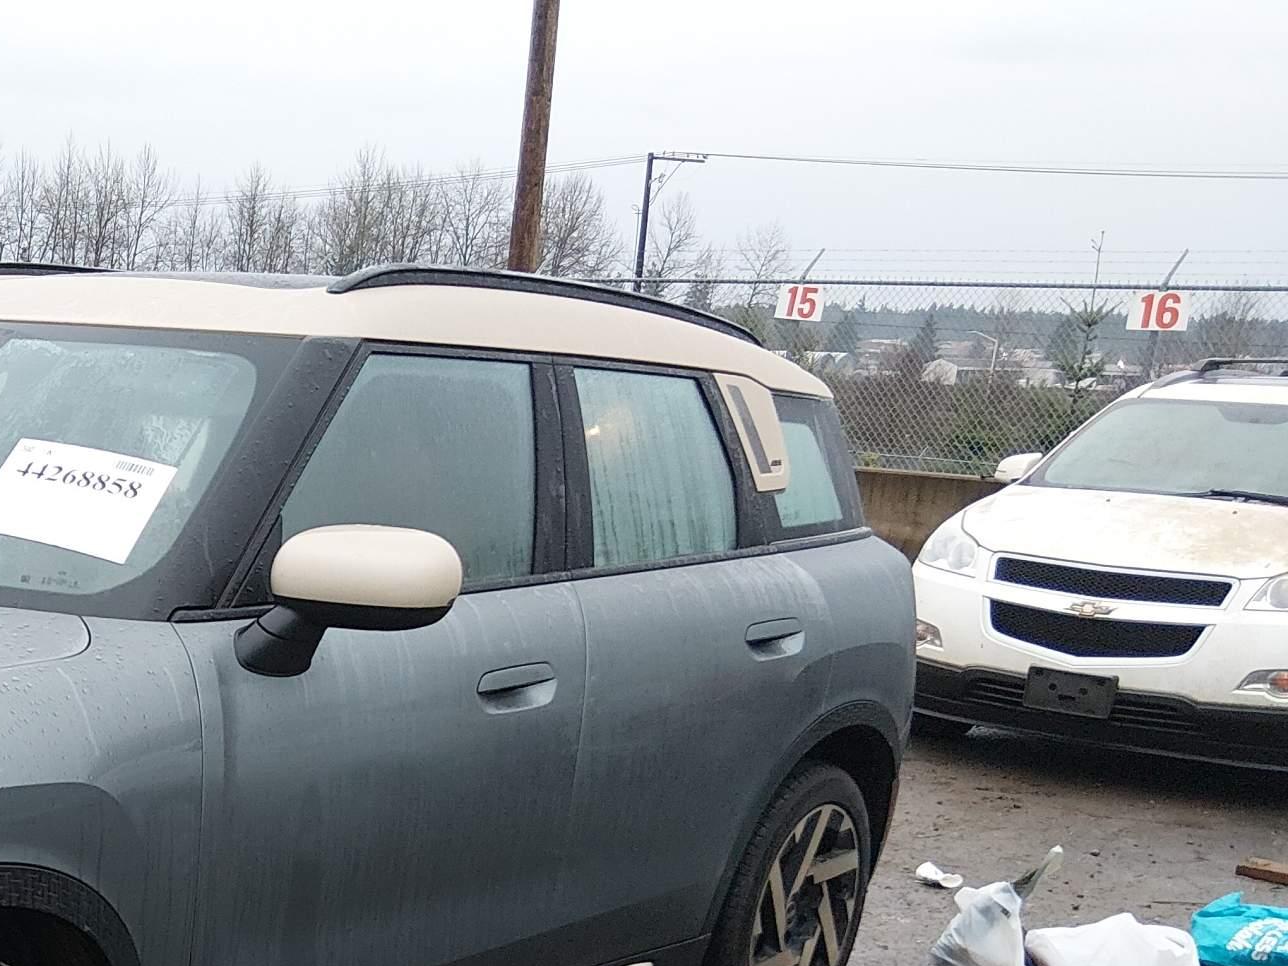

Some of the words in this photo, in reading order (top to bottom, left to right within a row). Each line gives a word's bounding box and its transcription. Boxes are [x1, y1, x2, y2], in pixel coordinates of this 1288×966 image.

[785, 286, 819, 319] 15
[1140, 292, 1182, 330] 16
[16, 461, 143, 499] 44268858
